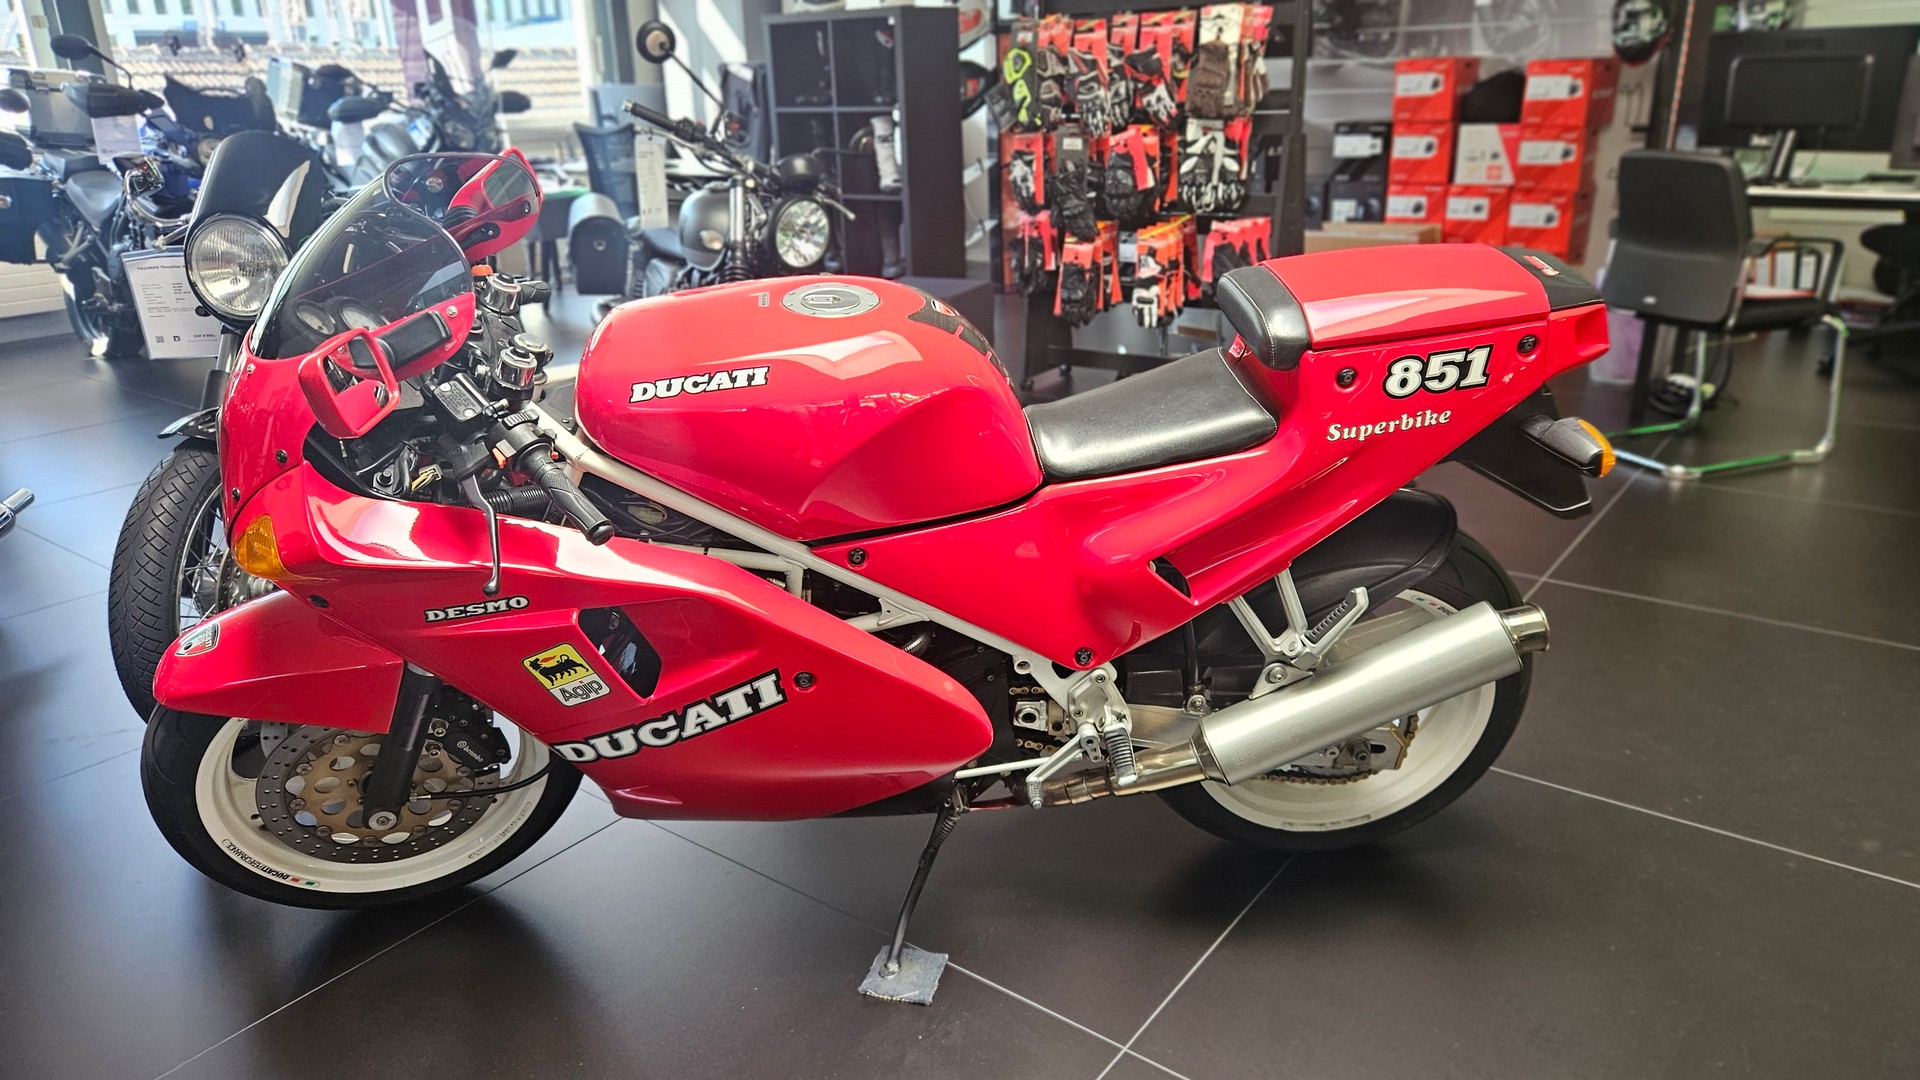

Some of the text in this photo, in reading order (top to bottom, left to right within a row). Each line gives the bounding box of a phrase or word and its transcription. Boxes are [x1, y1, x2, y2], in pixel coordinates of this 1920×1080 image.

[629, 366, 770, 403] DUCATI
[1384, 346, 1491, 397] 851
[1326, 409, 1462, 442] Superbike
[425, 596, 529, 622] DESMO
[558, 678, 603, 703] Agip
[552, 671, 786, 763] DUCATI
